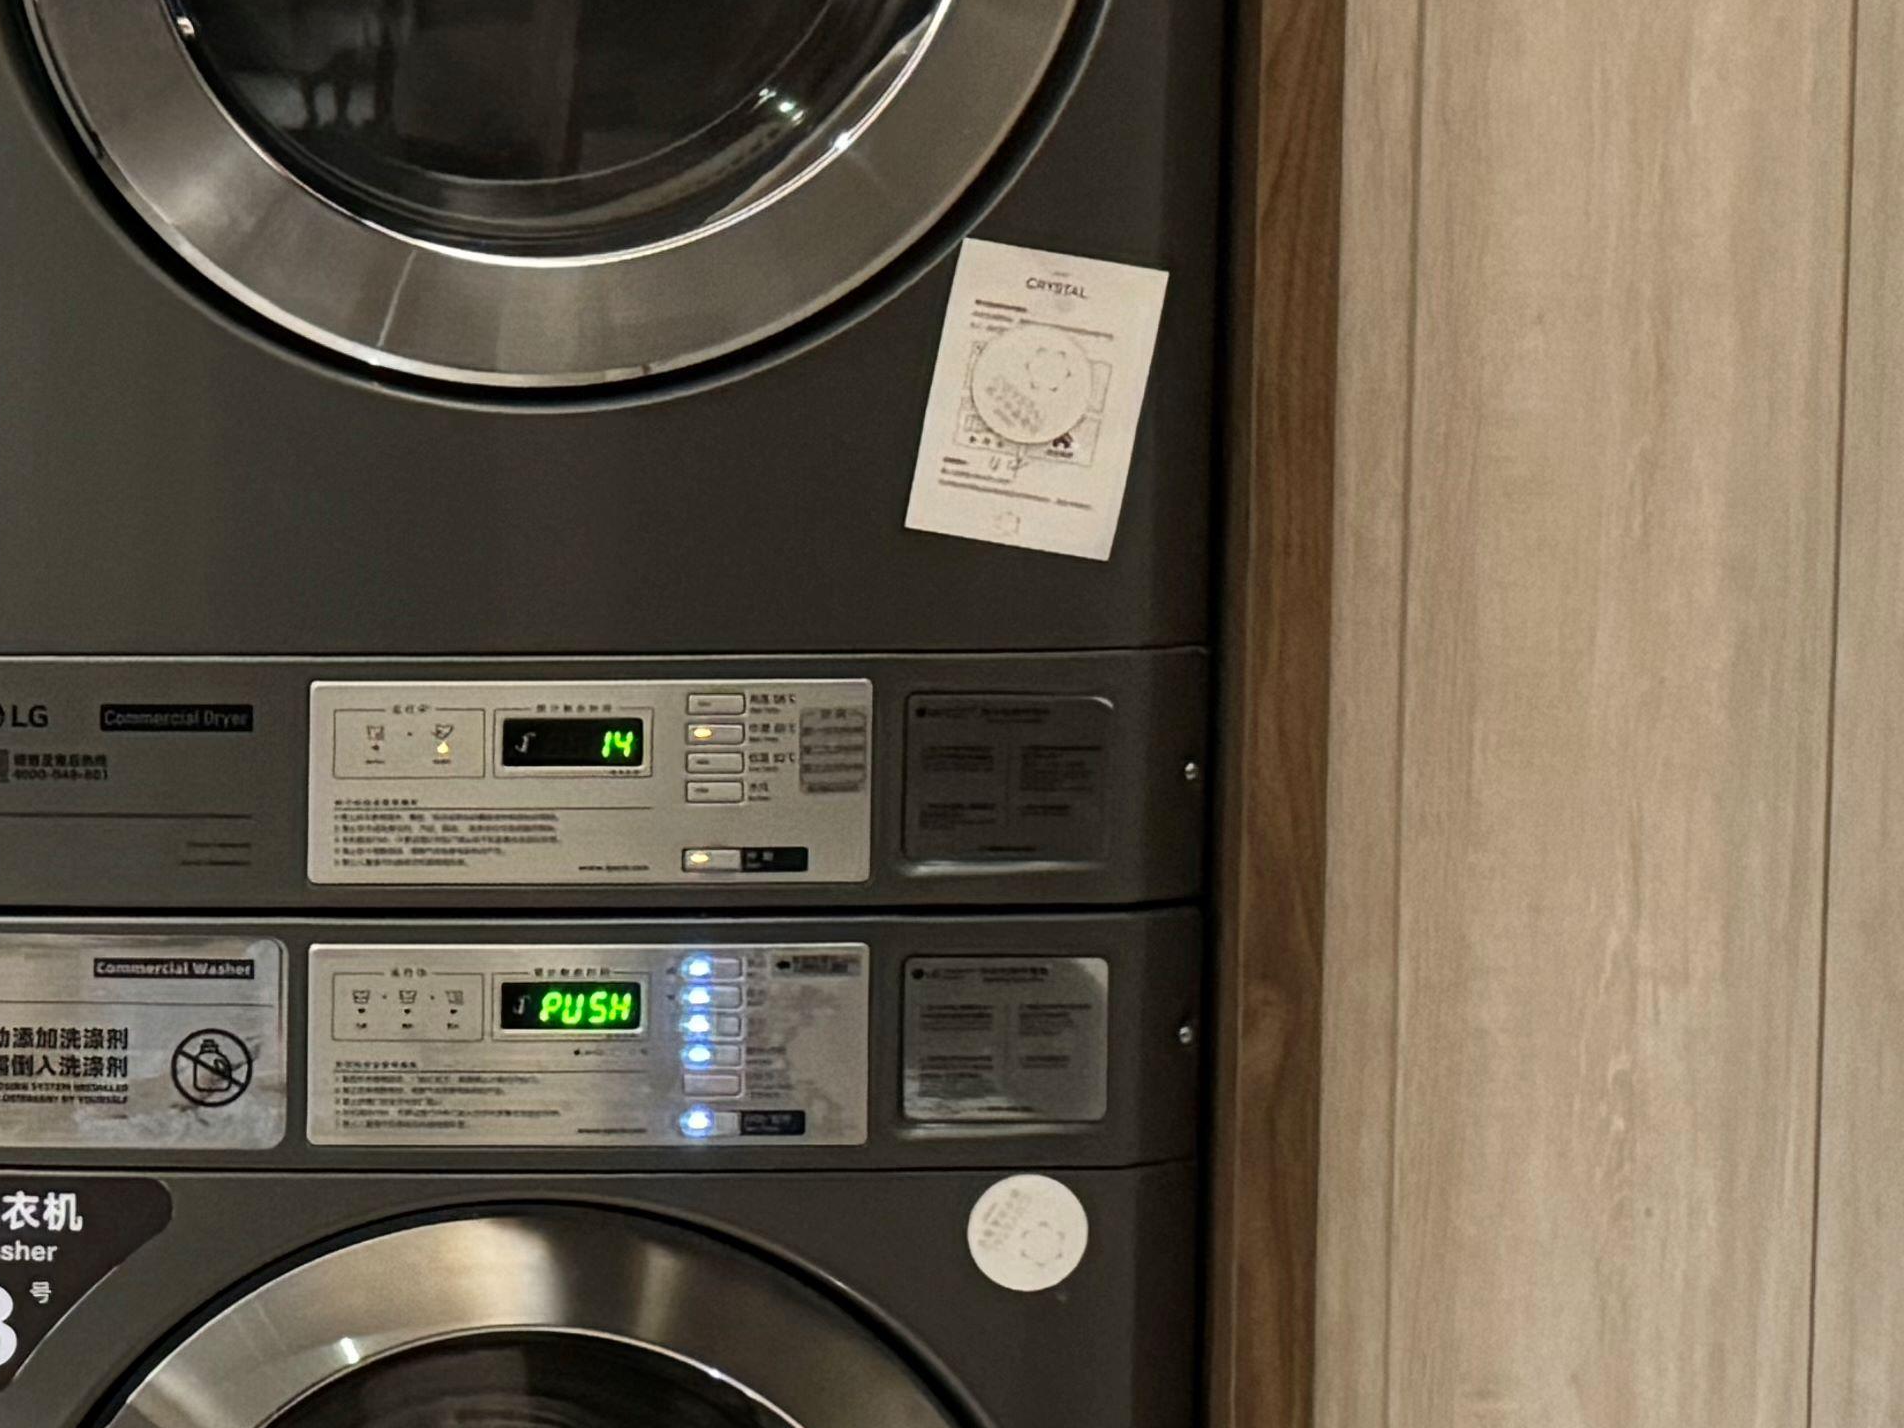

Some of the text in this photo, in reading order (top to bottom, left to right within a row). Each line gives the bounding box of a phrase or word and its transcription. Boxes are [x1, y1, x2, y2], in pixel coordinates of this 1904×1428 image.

[1026, 276, 1087, 298] CRYSTAL
[11, 704, 249, 729] LG Commercial Dryer
[602, 732, 633, 757] 14
[95, 960, 189, 977] Commercial
[192, 960, 252, 978] Washer
[539, 990, 632, 1025] PUSH
[29, 1281, 51, 1304] 号
